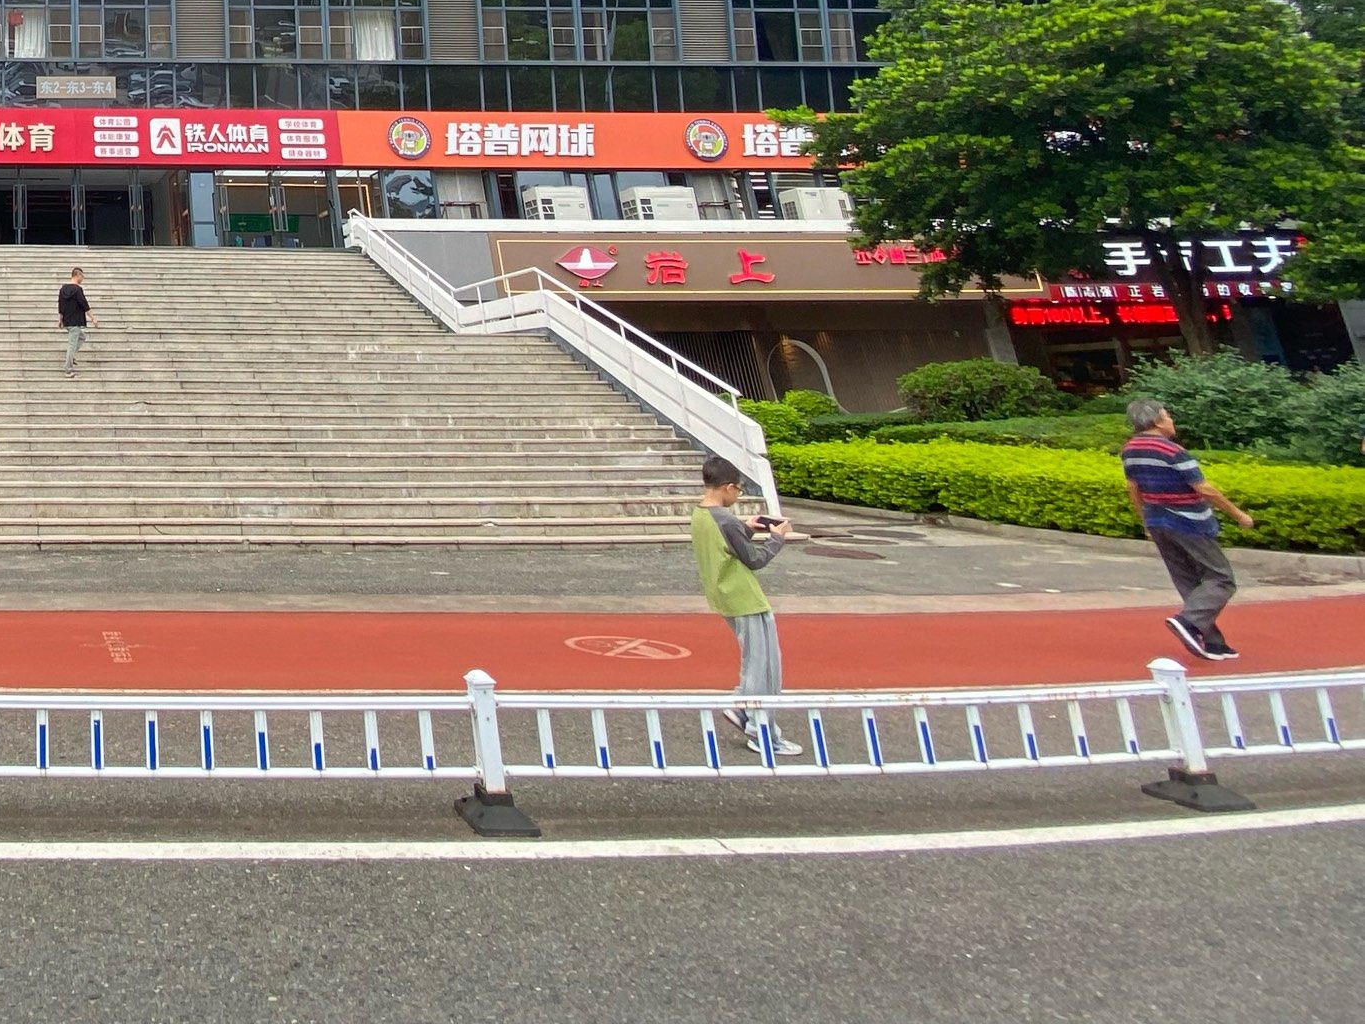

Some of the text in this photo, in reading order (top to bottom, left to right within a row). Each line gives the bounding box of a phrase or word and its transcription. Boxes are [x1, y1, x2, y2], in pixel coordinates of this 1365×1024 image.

[40, 79, 113, 95] 东2-东3-东4
[185, 123, 269, 142] 铁人体育
[445, 122, 596, 157] 塔普网球
[187, 142, 270, 153] IRONMAN
[1102, 236, 1296, 275] 手工夫
